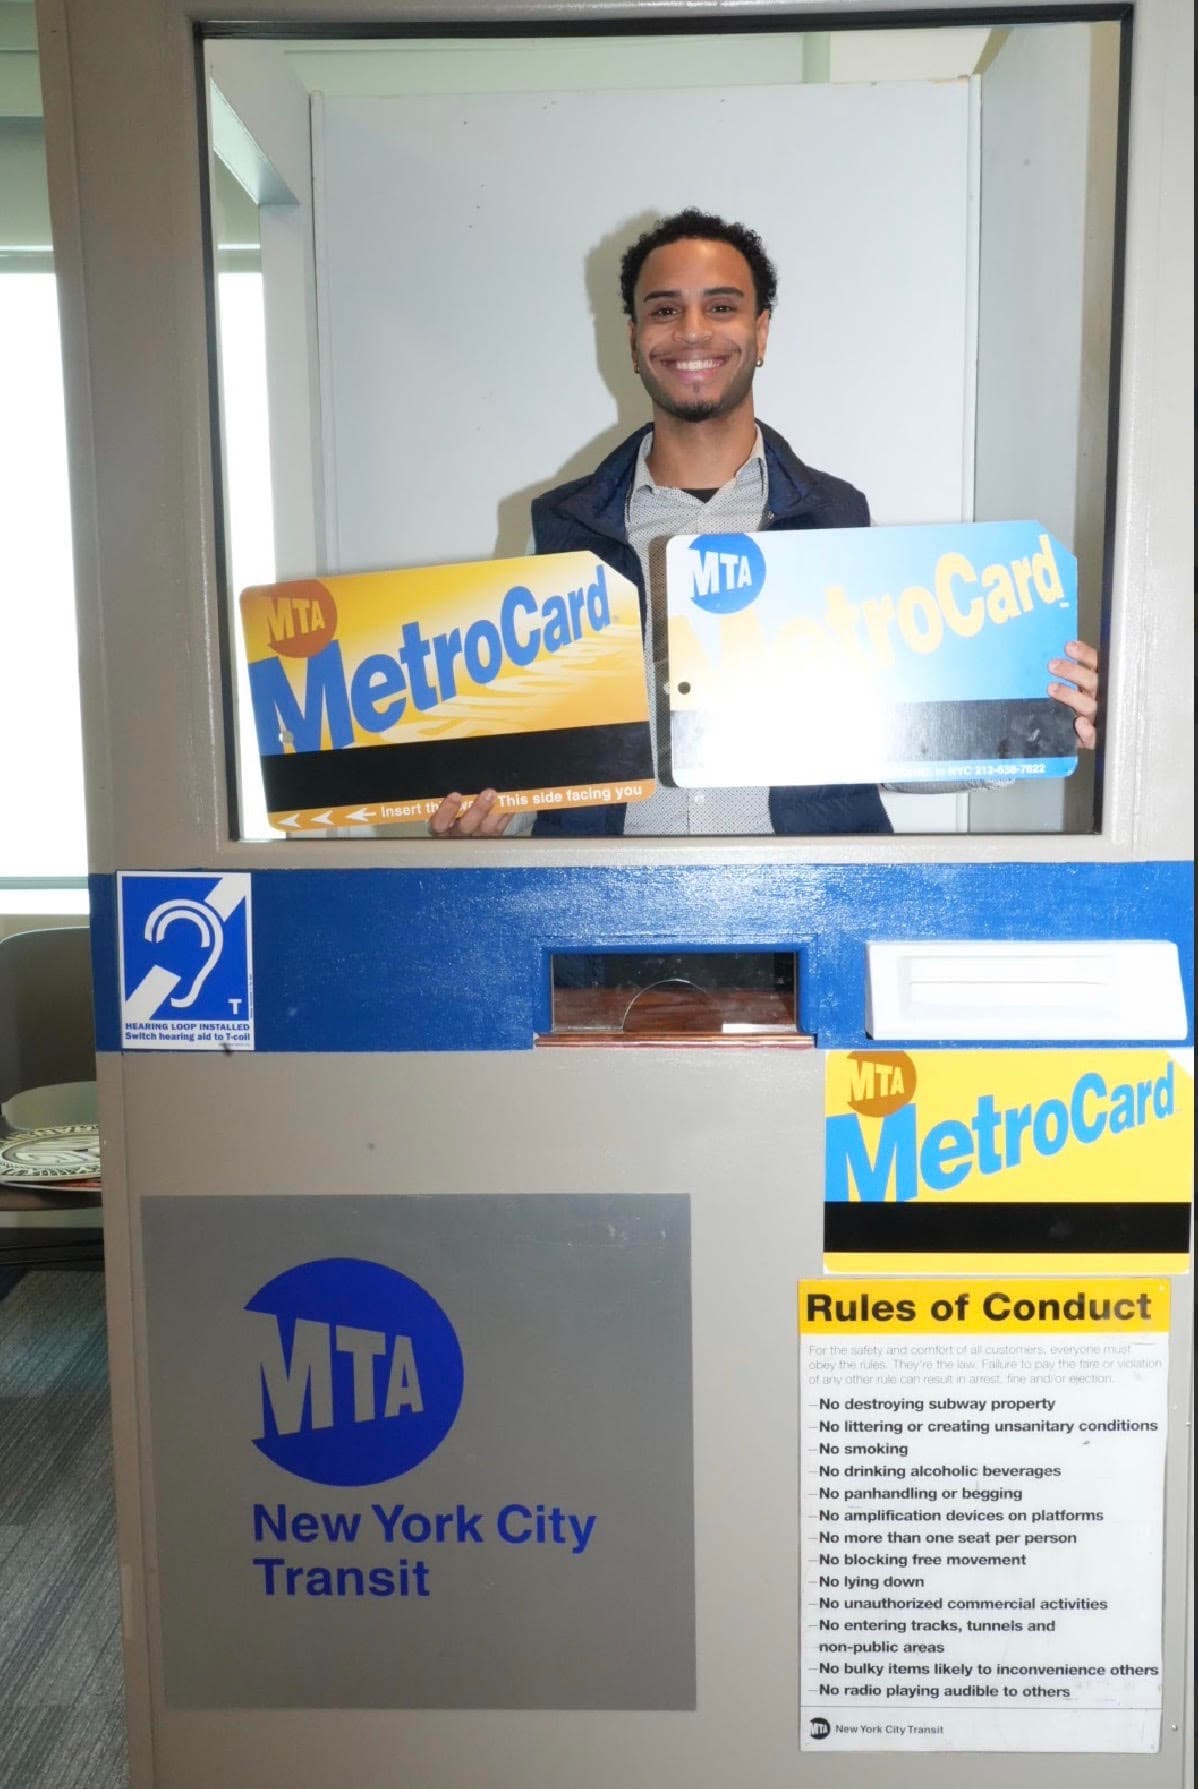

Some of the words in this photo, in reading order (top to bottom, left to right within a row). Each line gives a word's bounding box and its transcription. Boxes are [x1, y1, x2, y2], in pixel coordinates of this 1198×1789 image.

[688, 550, 752, 597] MTA
[266, 597, 326, 644] MTA
[248, 564, 611, 755] MetroCard
[381, 802, 421, 817] Insert
[498, 794, 528, 807] This
[532, 792, 562, 805] side
[566, 788, 612, 804] facing
[615, 785, 642, 800] you
[228, 999, 242, 1014] T
[125, 1032, 156, 1040] Switch
[160, 1032, 194, 1041] hearing
[197, 1032, 211, 1040] aid
[848, 1059, 905, 1101] MTA
[826, 1061, 1174, 1202] MetroCard
[807, 1293, 916, 1322] Rules
[931, 1293, 969, 1321] of
[983, 1291, 1151, 1321] Conduct
[246, 1311, 424, 1439] MTA
[819, 1399, 839, 1410] No
[845, 1399, 923, 1411] destroying
[929, 1399, 987, 1411] subway
[992, 1398, 1056, 1411] property
[819, 1421, 839, 1432] No
[844, 1420, 903, 1434] littering
[907, 1422, 922, 1432] or
[928, 1420, 989, 1434] creating
[995, 1420, 1074, 1433] unsanitary
[1079, 1420, 1158, 1431] conditions
[819, 1443, 839, 1454] No
[844, 1443, 908, 1457] smoking
[819, 1466, 839, 1477] No
[844, 1466, 905, 1479] drinking
[911, 1466, 978, 1477] alcoholic
[983, 1466, 1061, 1478] beverages
[819, 1488, 839, 1499] No
[844, 1487, 937, 1501] panhandling
[942, 1489, 958, 1499] or
[962, 1487, 1022, 1501] begging
[819, 1510, 839, 1521] No
[844, 1510, 941, 1524] amplification
[946, 1510, 1004, 1521] devices
[1008, 1512, 1027, 1521] on
[1032, 1510, 1104, 1524] platforms
[253, 1504, 362, 1542] New
[371, 1504, 484, 1543] York
[497, 1504, 598, 1554] City
[819, 1532, 839, 1544] No
[844, 1534, 882, 1544] more
[888, 1532, 921, 1544] than
[926, 1534, 954, 1544] one
[958, 1533, 991, 1544] seat
[995, 1534, 1020, 1546] per
[1025, 1534, 1077, 1546] person
[819, 1554, 839, 1566] No
[844, 1554, 907, 1568] blocking
[912, 1554, 942, 1566] free
[946, 1555, 1027, 1566] movement
[252, 1558, 430, 1596] Transit
[819, 1576, 839, 1588] No
[844, 1576, 879, 1590] lying
[883, 1576, 924, 1588] down
[819, 1598, 839, 1609] No
[844, 1598, 942, 1609] unauthorized
[947, 1598, 1035, 1610] commercial
[1040, 1598, 1108, 1610] activities
[819, 1620, 839, 1631] No
[844, 1620, 906, 1633] entering
[911, 1620, 962, 1633] tracks,
[967, 1620, 1023, 1631] tunnels
[1027, 1620, 1056, 1631] and
[819, 1641, 898, 1655] non-public
[903, 1643, 945, 1653] areas
[819, 1663, 839, 1674] No
[844, 1663, 883, 1677] bulky
[888, 1663, 930, 1675] items
[934, 1663, 973, 1677] likely
[977, 1664, 992, 1675] to
[997, 1663, 1106, 1676] inconvenience
[1110, 1664, 1159, 1676] others
[819, 1685, 839, 1696] No
[844, 1684, 881, 1696] radio
[886, 1685, 940, 1699] playing
[944, 1685, 998, 1697] audible
[1004, 1686, 1018, 1697] to
[1023, 1686, 1071, 1698] others
[836, 1725, 858, 1733] New
[886, 1725, 905, 1735] City
[909, 1726, 944, 1734] Transit
